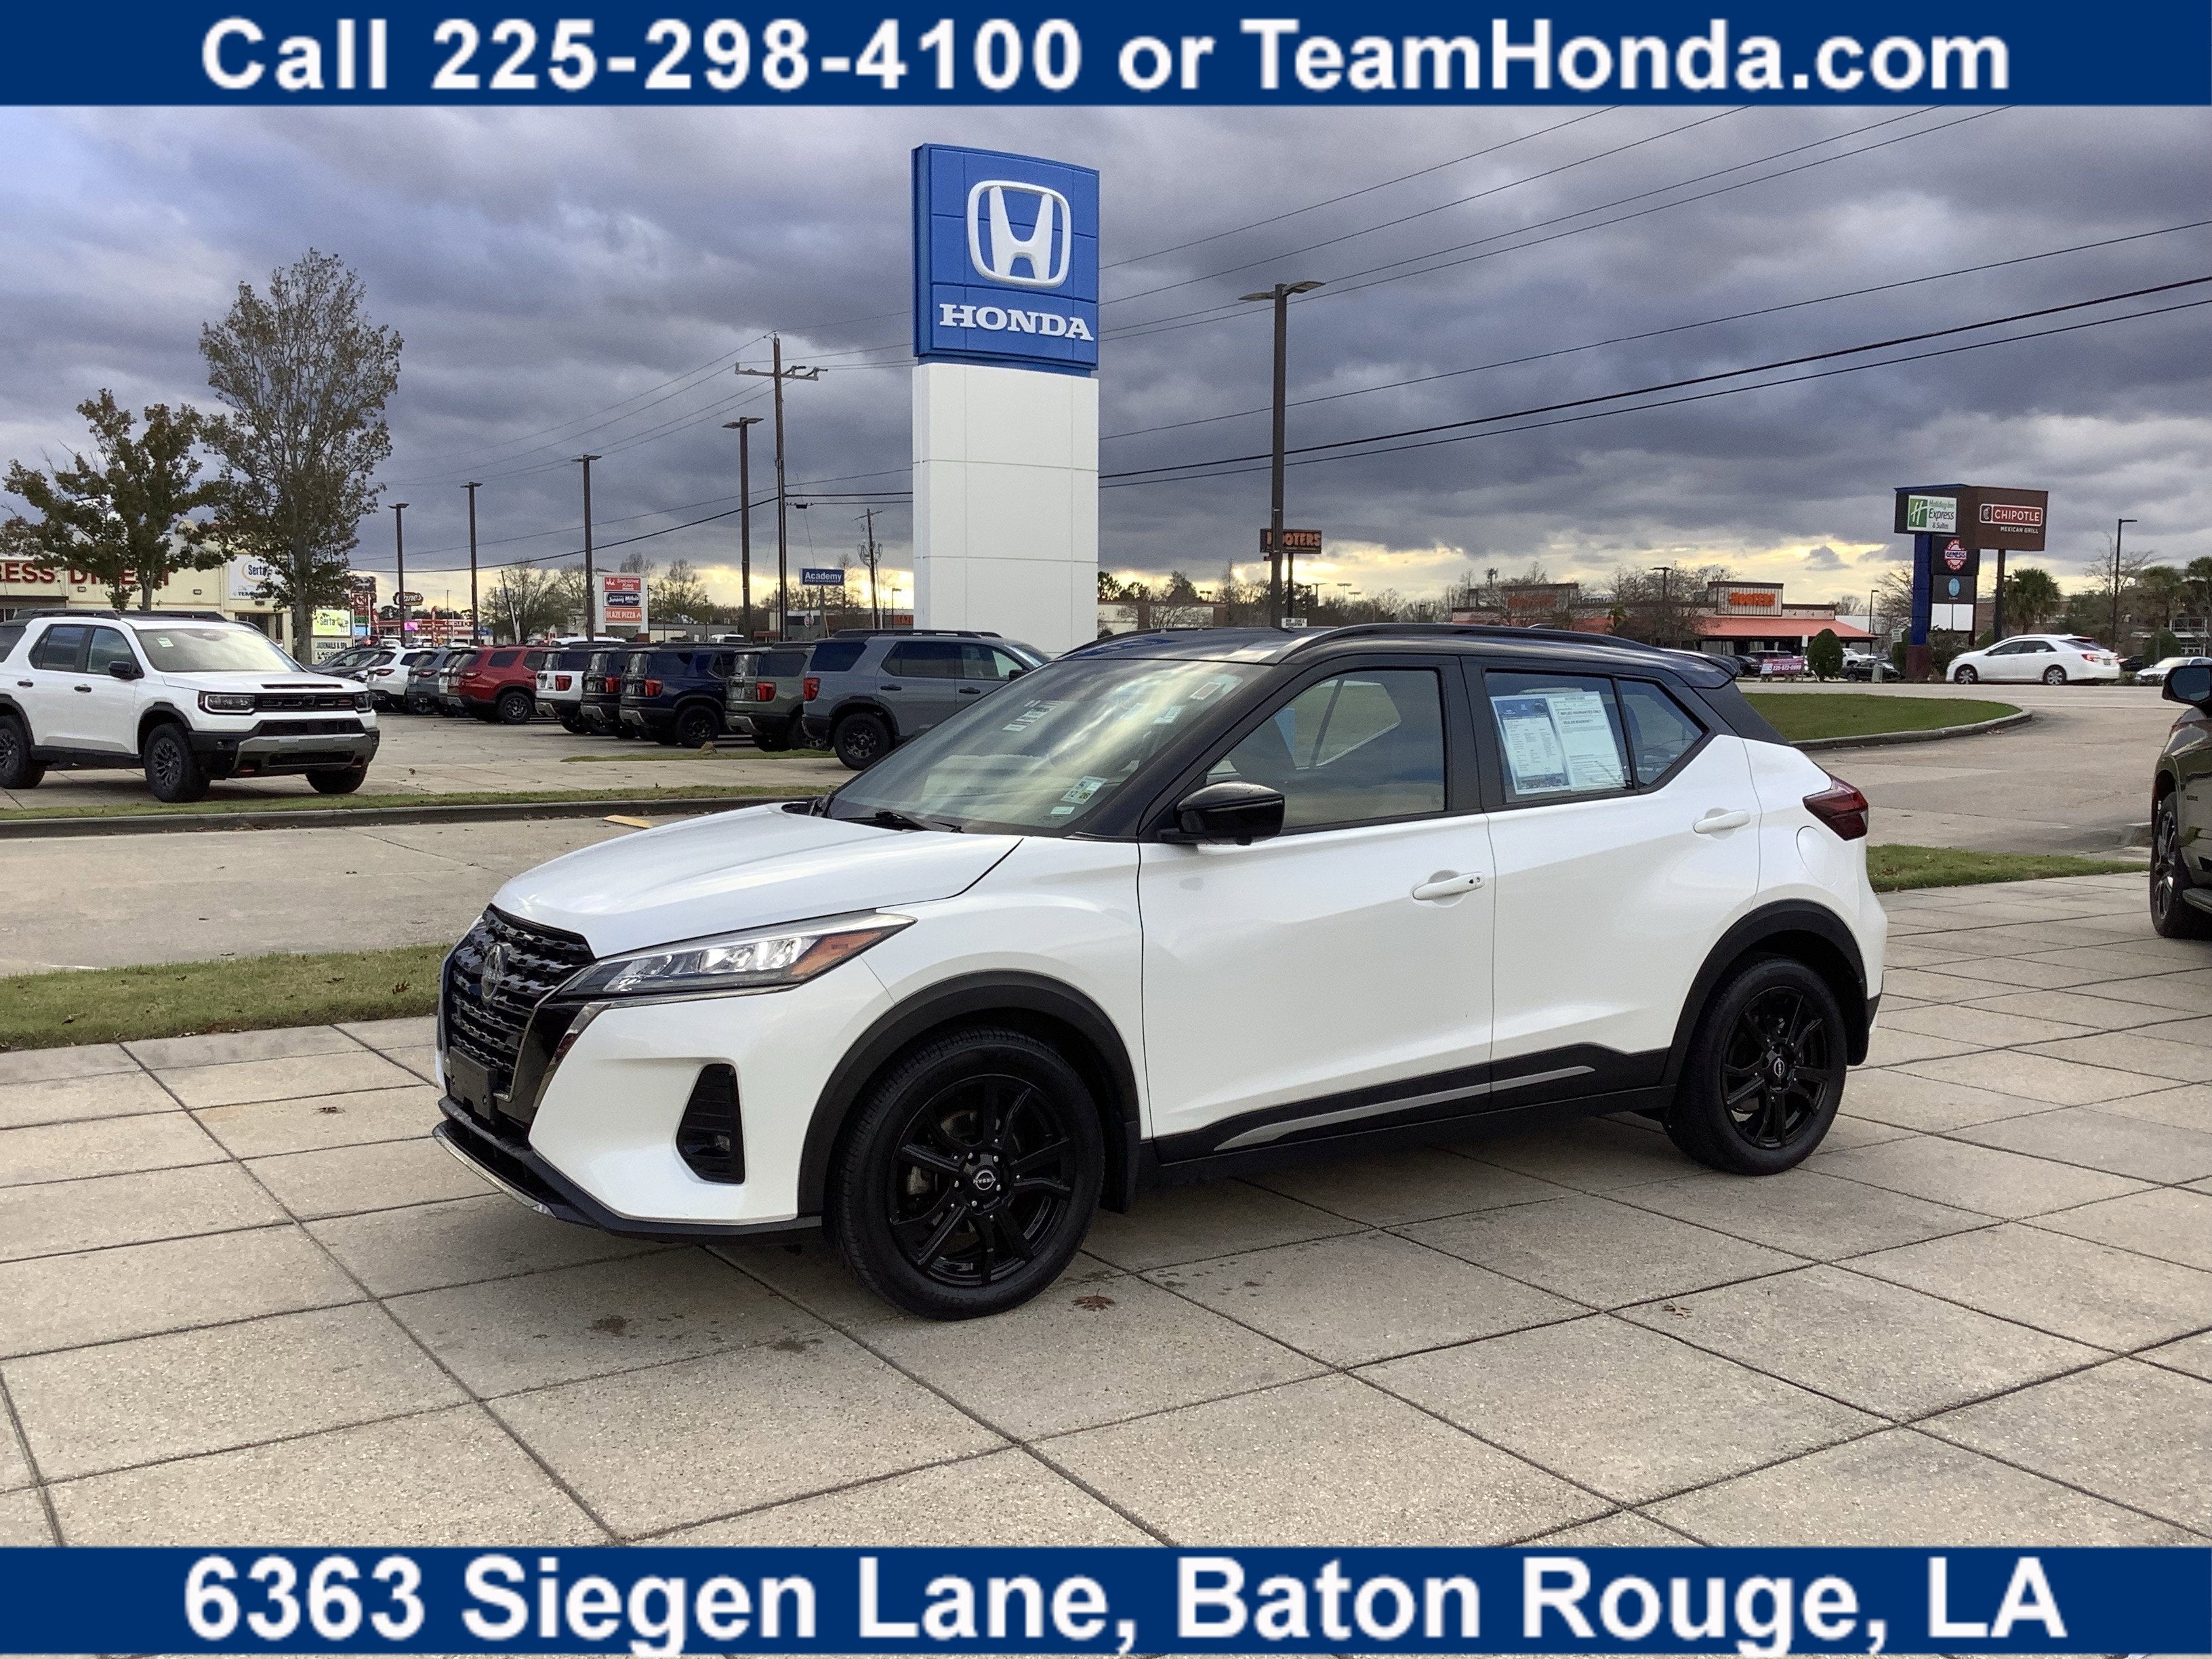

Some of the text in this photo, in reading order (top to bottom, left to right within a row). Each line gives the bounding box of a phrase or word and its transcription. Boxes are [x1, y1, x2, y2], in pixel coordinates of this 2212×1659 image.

[939, 304, 1094, 342] HONDA
[1928, 508, 1954, 521] Express
[1994, 509, 2040, 522] CHIPOTLE
[1267, 531, 1322, 546] OTERS
[804, 571, 842, 582] Academy
[621, 611, 636, 619] PIZZA
